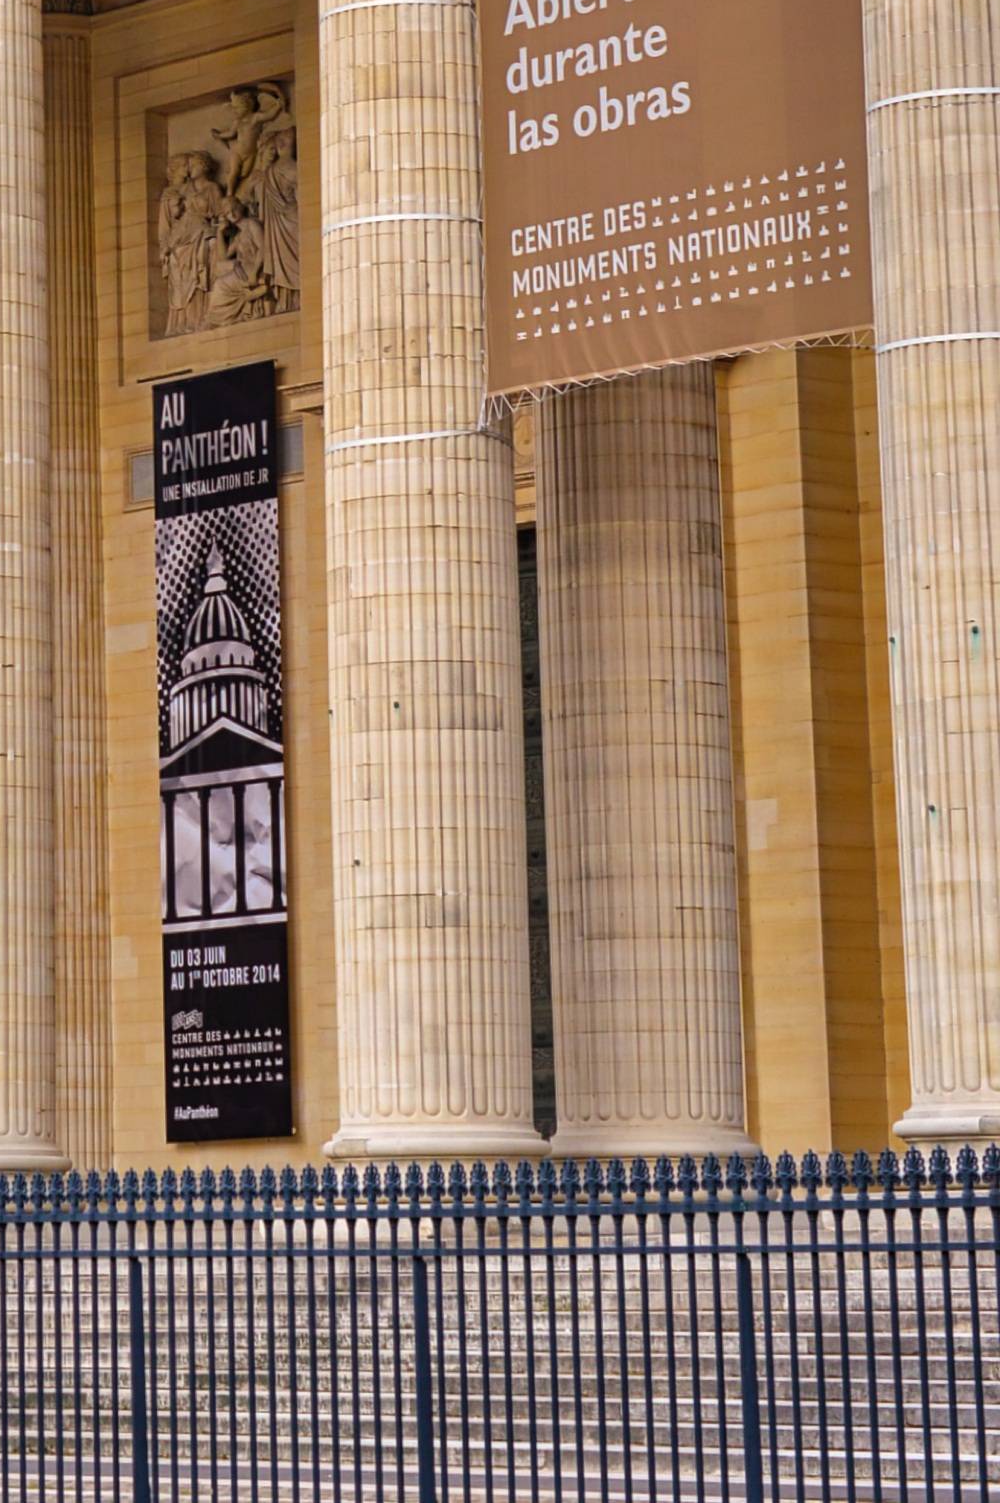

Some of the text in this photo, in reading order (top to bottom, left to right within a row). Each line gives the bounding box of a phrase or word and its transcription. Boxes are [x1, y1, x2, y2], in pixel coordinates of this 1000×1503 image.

[506, 22, 668, 94] durante
[507, 75, 691, 155] las obras
[511, 201, 646, 256] CENTRE DES
[512, 210, 812, 297] MONUMENTS NATIONAUX
[160, 392, 185, 430] AU
[162, 419, 256, 475] PANTHÉON
[162, 468, 269, 502] UNE INSTALLATION DE JR
[170, 945, 226, 968] DU 03 JUIN
[171, 971, 185, 990] AU
[203, 966, 249, 988] OCTOBRE
[252, 963, 280, 984] 2014
[172, 1030, 222, 1044] CENTRE DES
[172, 1041, 274, 1059] MONUMENTS NATIONAUX
